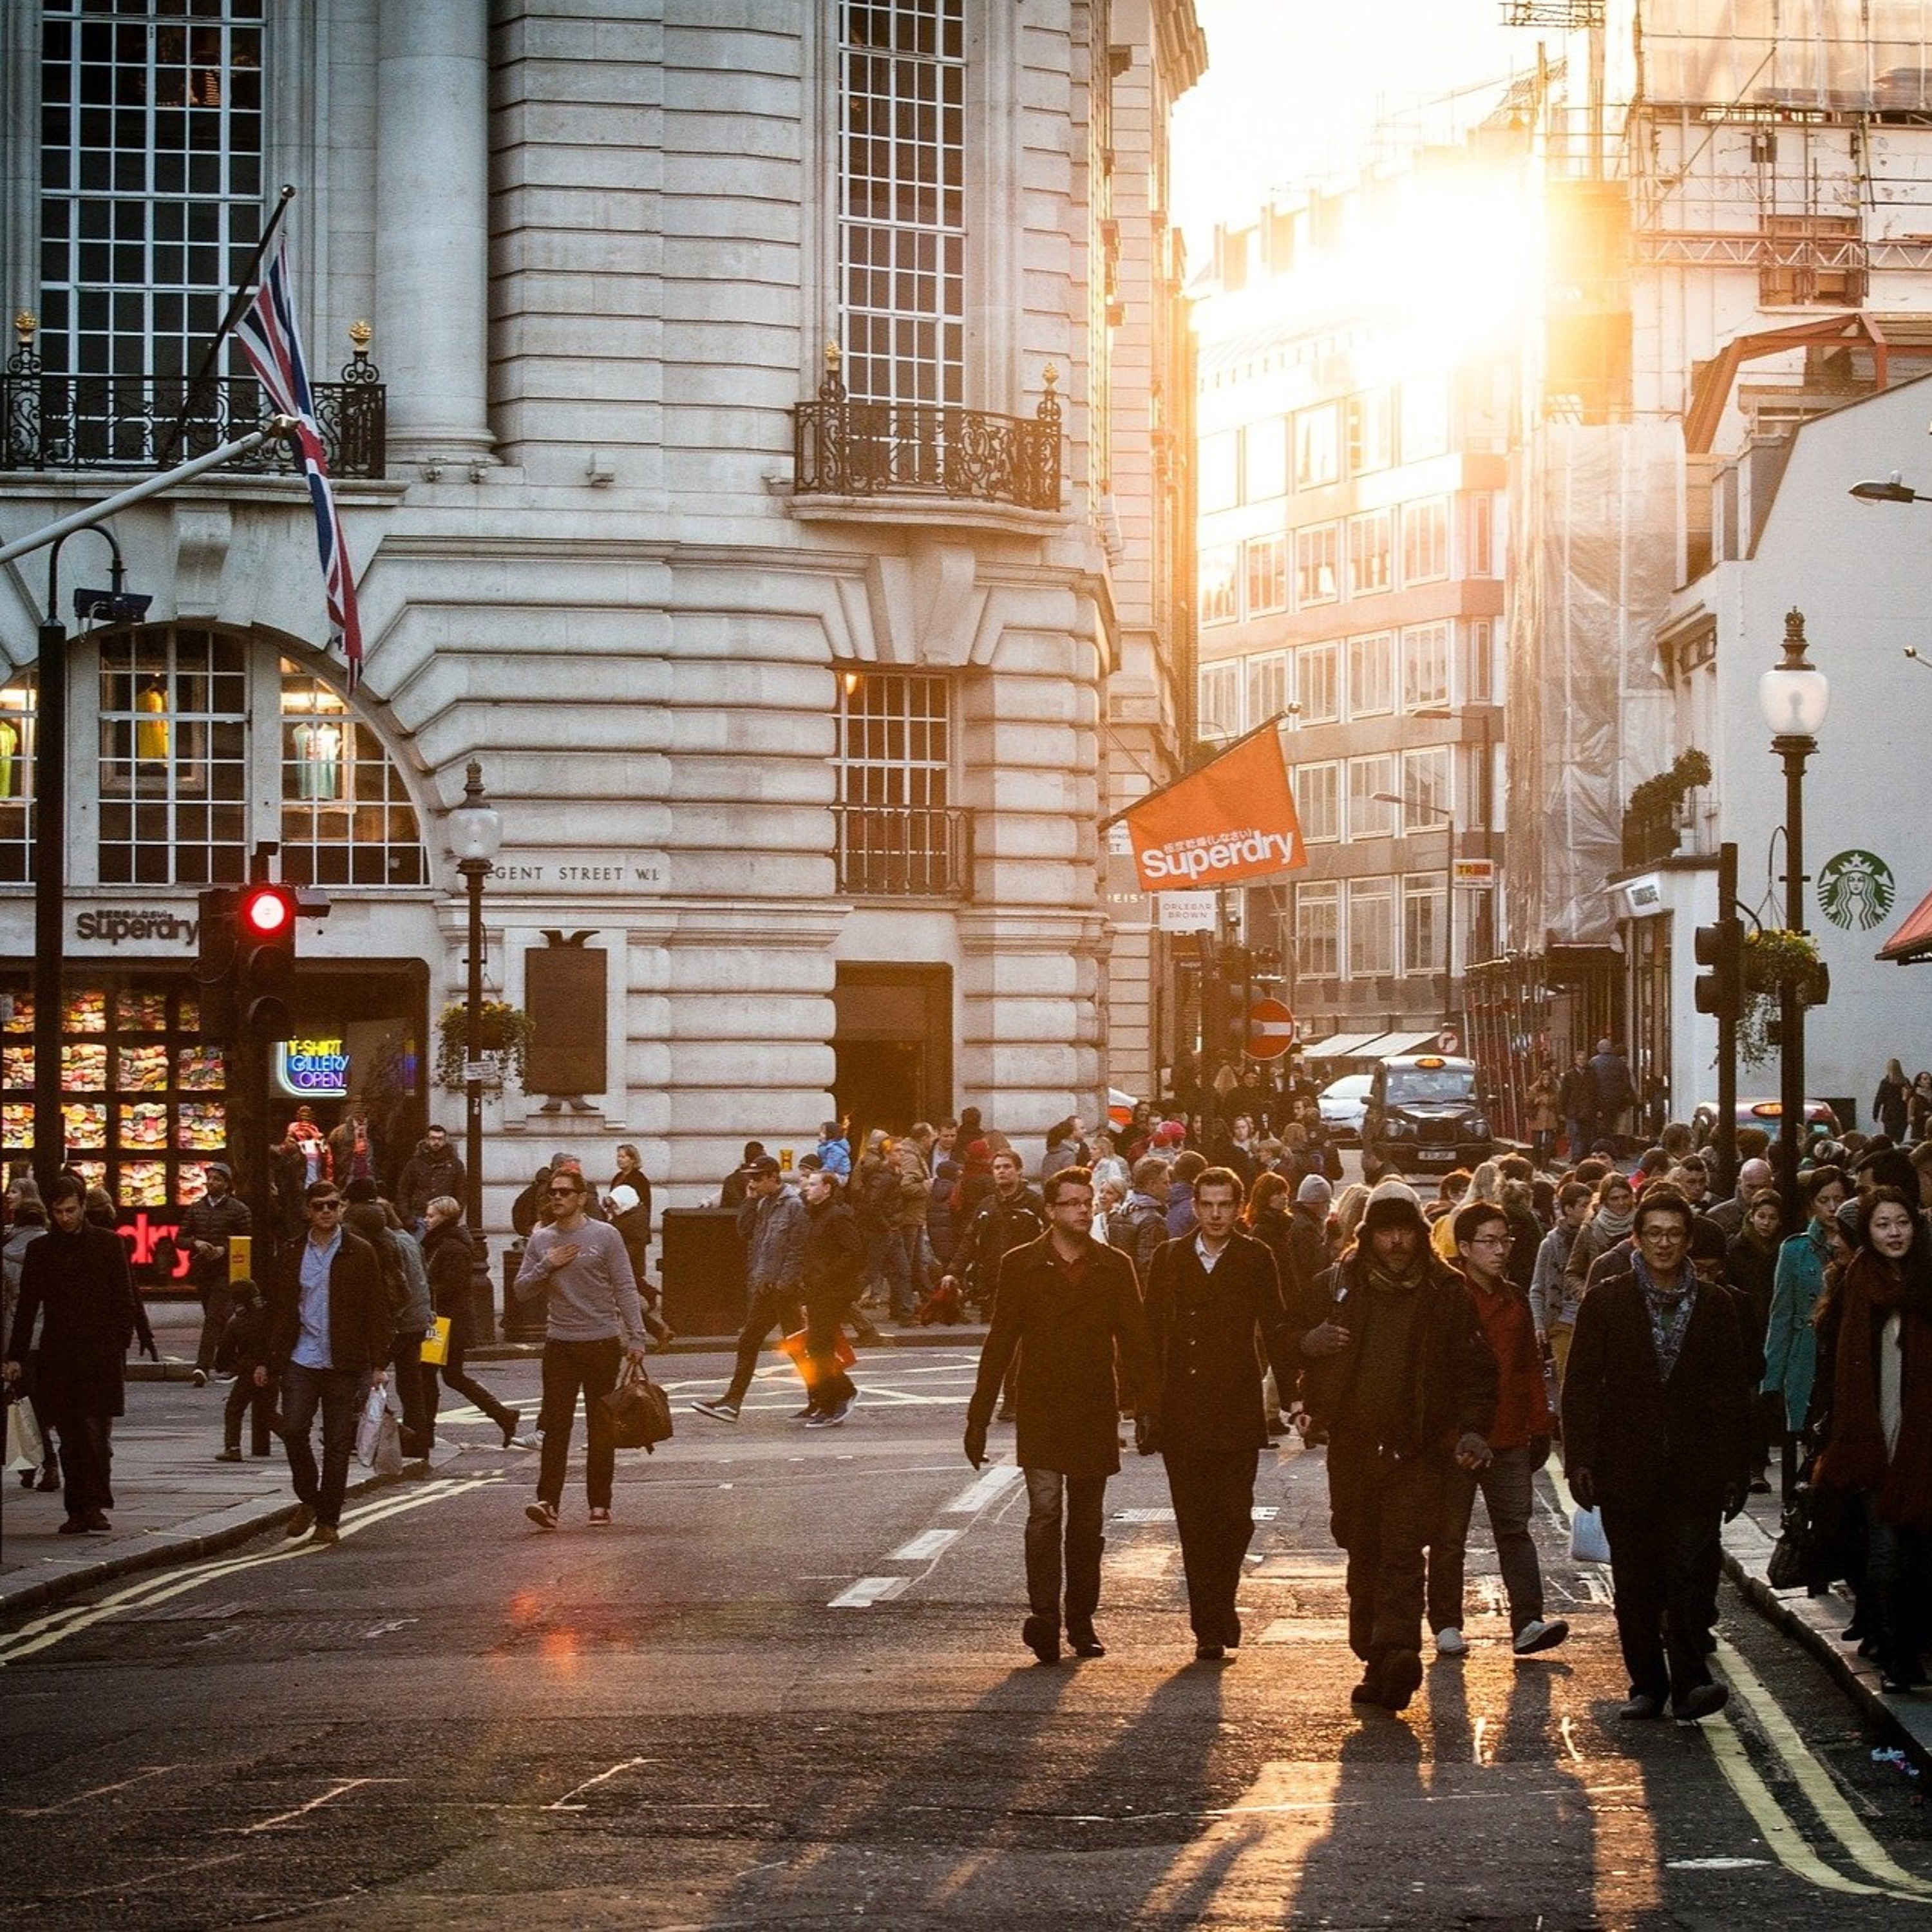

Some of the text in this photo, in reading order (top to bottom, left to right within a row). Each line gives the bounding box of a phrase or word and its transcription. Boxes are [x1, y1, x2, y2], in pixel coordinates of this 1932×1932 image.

[1142, 830, 1293, 880] Superdry
[486, 867, 543, 880] GENT
[559, 867, 623, 880] STREET
[77, 913, 200, 946] Superdry
[289, 1040, 343, 1056] T-SHIRT
[292, 1056, 349, 1071] GALLERY
